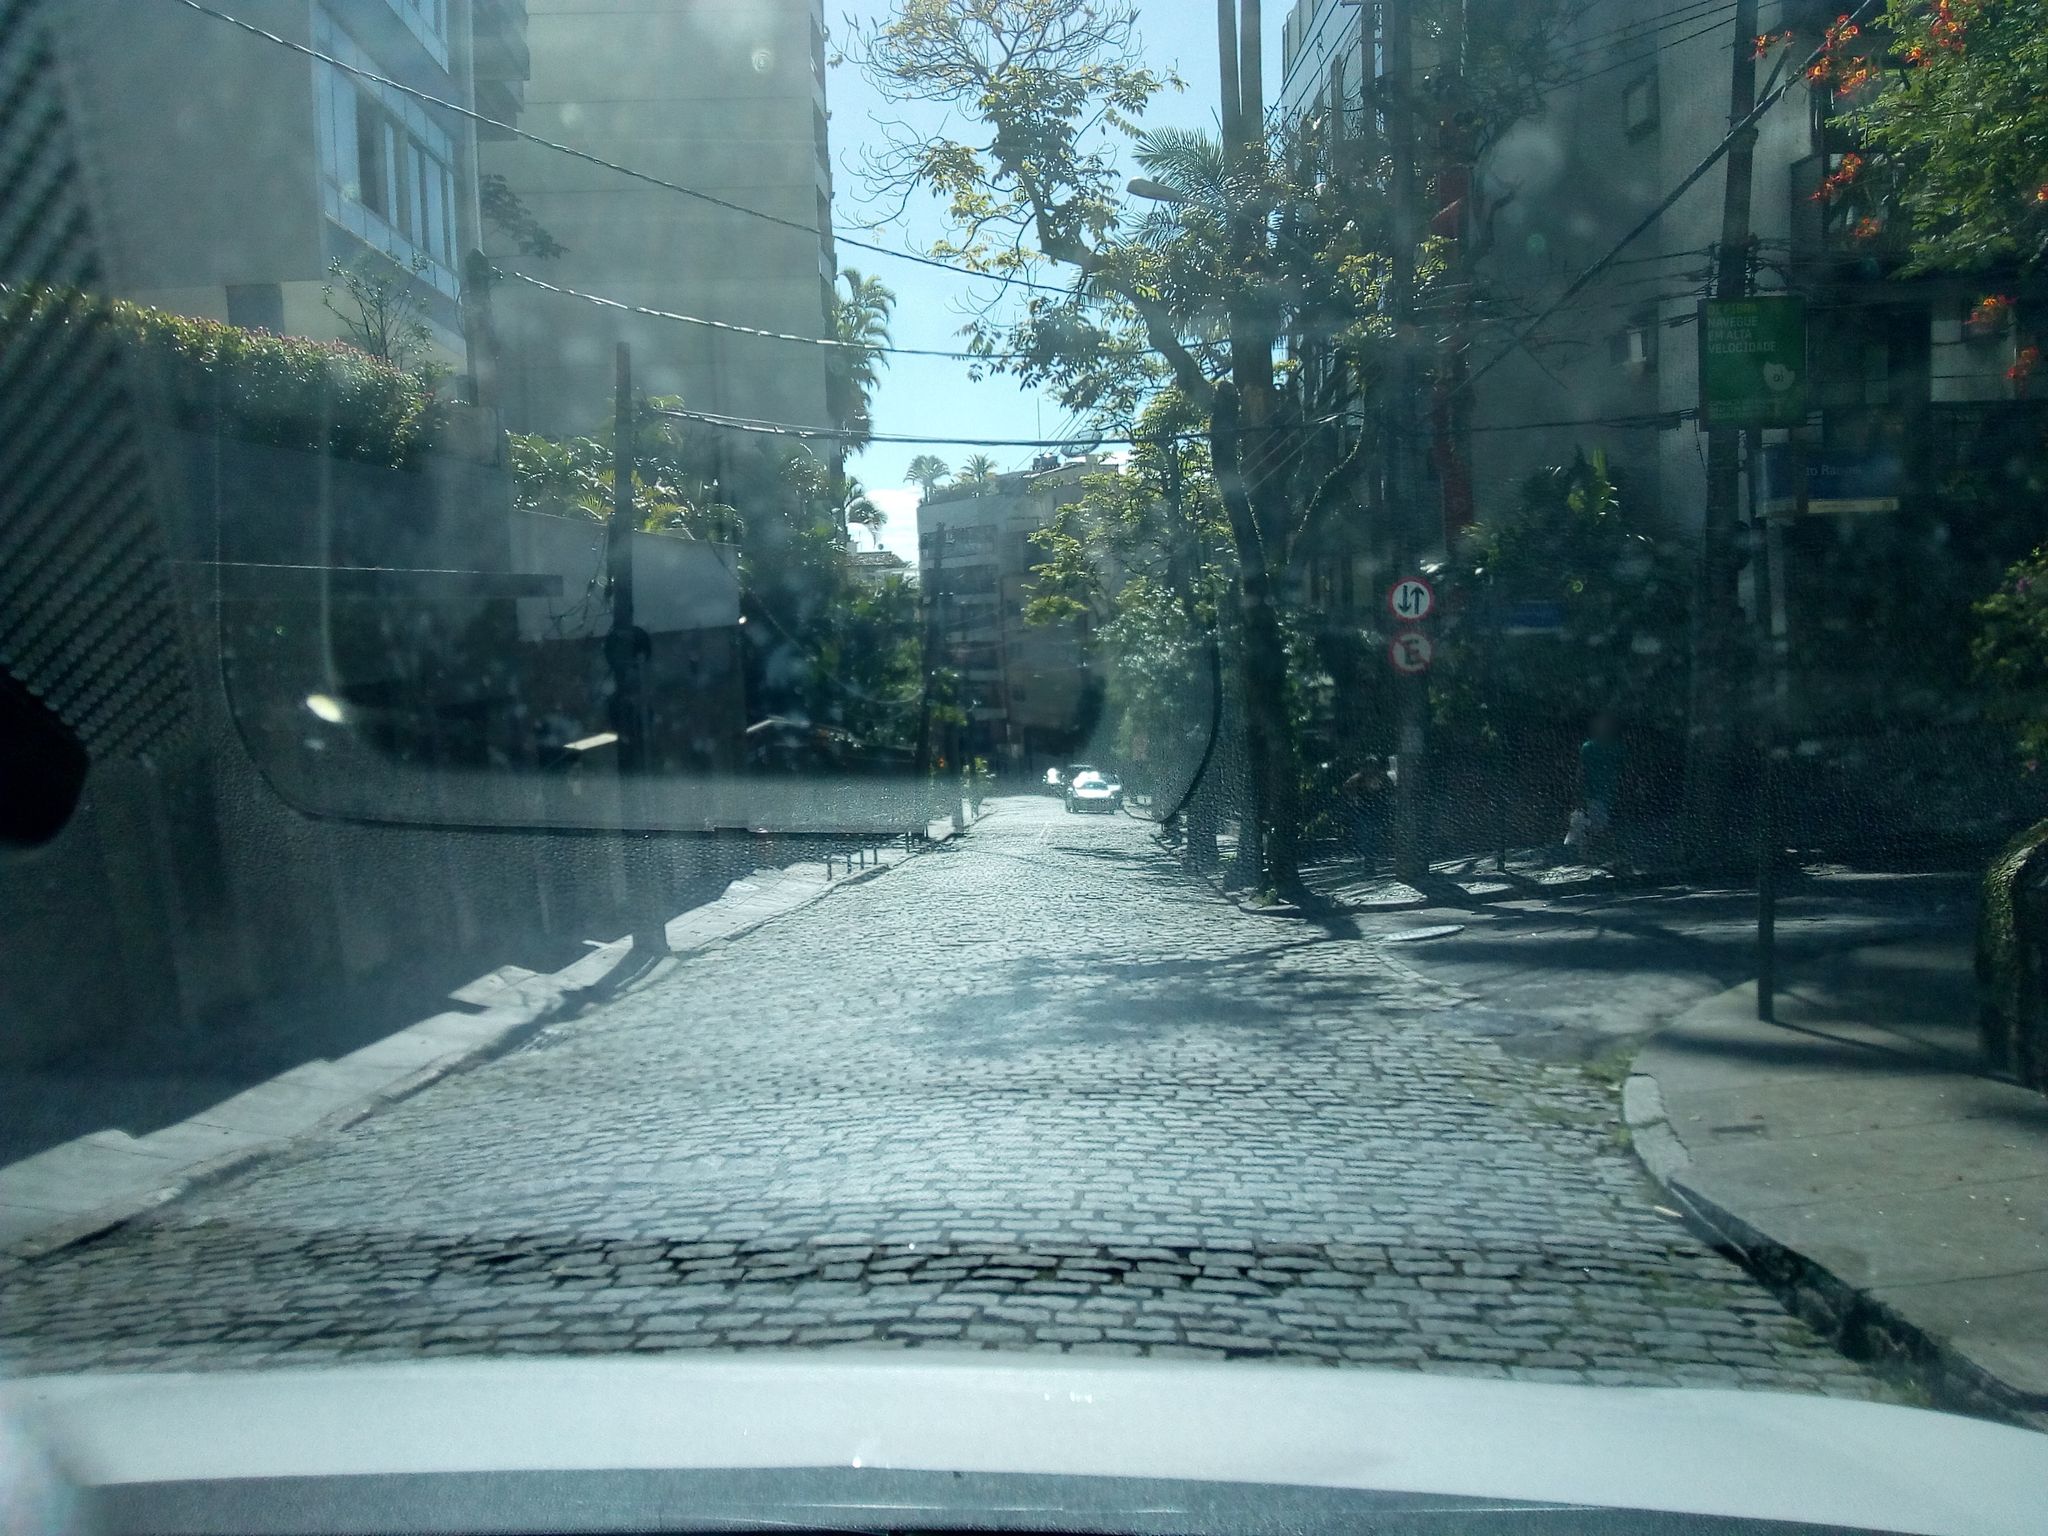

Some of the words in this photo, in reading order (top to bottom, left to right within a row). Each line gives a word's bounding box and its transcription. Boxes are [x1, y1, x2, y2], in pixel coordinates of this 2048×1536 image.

[1707, 316, 1759, 328] NAVEGUE
[1707, 330, 1723, 341] EM
[1726, 328, 1752, 340] ALTA
[1707, 341, 1777, 354] VELOCIDADE
[1403, 638, 1421, 665] E
